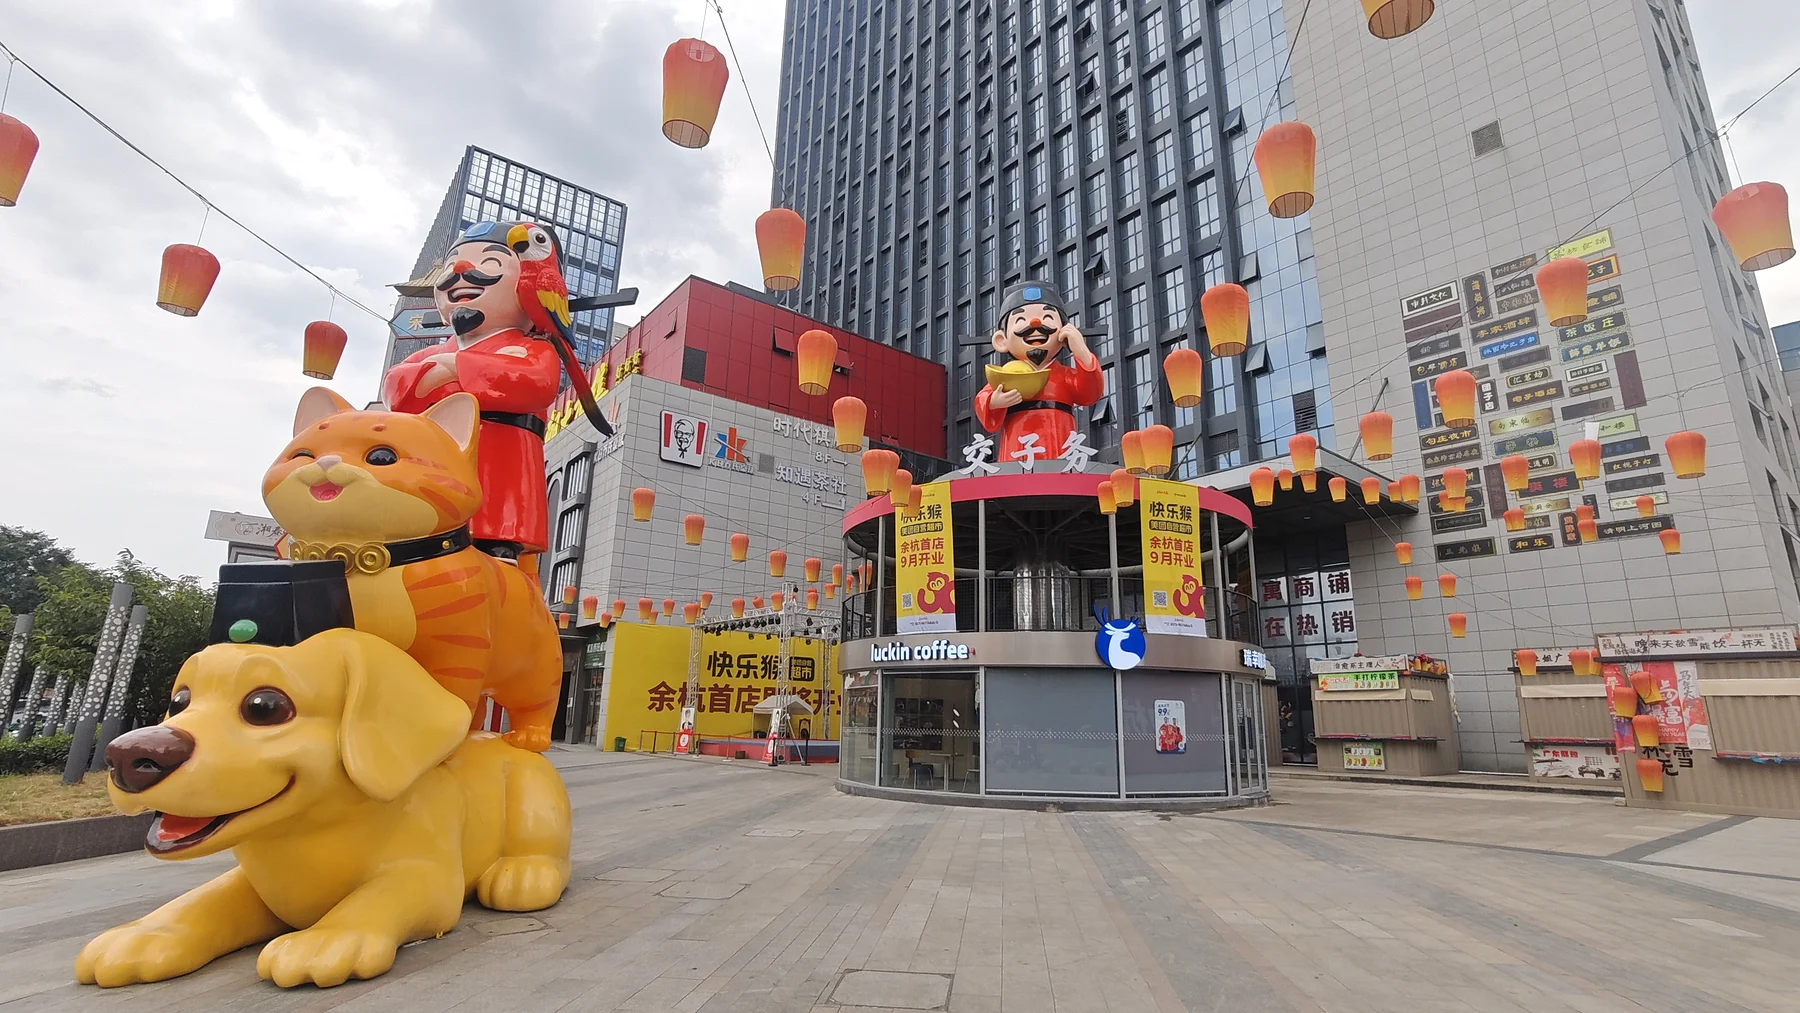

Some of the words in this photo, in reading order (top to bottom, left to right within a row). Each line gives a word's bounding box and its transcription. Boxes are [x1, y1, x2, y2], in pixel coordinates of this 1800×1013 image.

[773, 417, 838, 449] 时代棋
[815, 451, 831, 463] 8F
[958, 431, 1099, 475] 交子务
[776, 463, 847, 496] 知遇茶社
[1149, 501, 1192, 522] 快乐猴
[901, 537, 944, 554] 余杭首店
[1150, 536, 1194, 553] 余杭首店
[901, 552, 944, 568] 9月开业
[1150, 551, 1194, 568] 9月开业
[1264, 610, 1355, 639] 在热销
[871, 643, 911, 661] luckin
[914, 640, 968, 660] coffee
